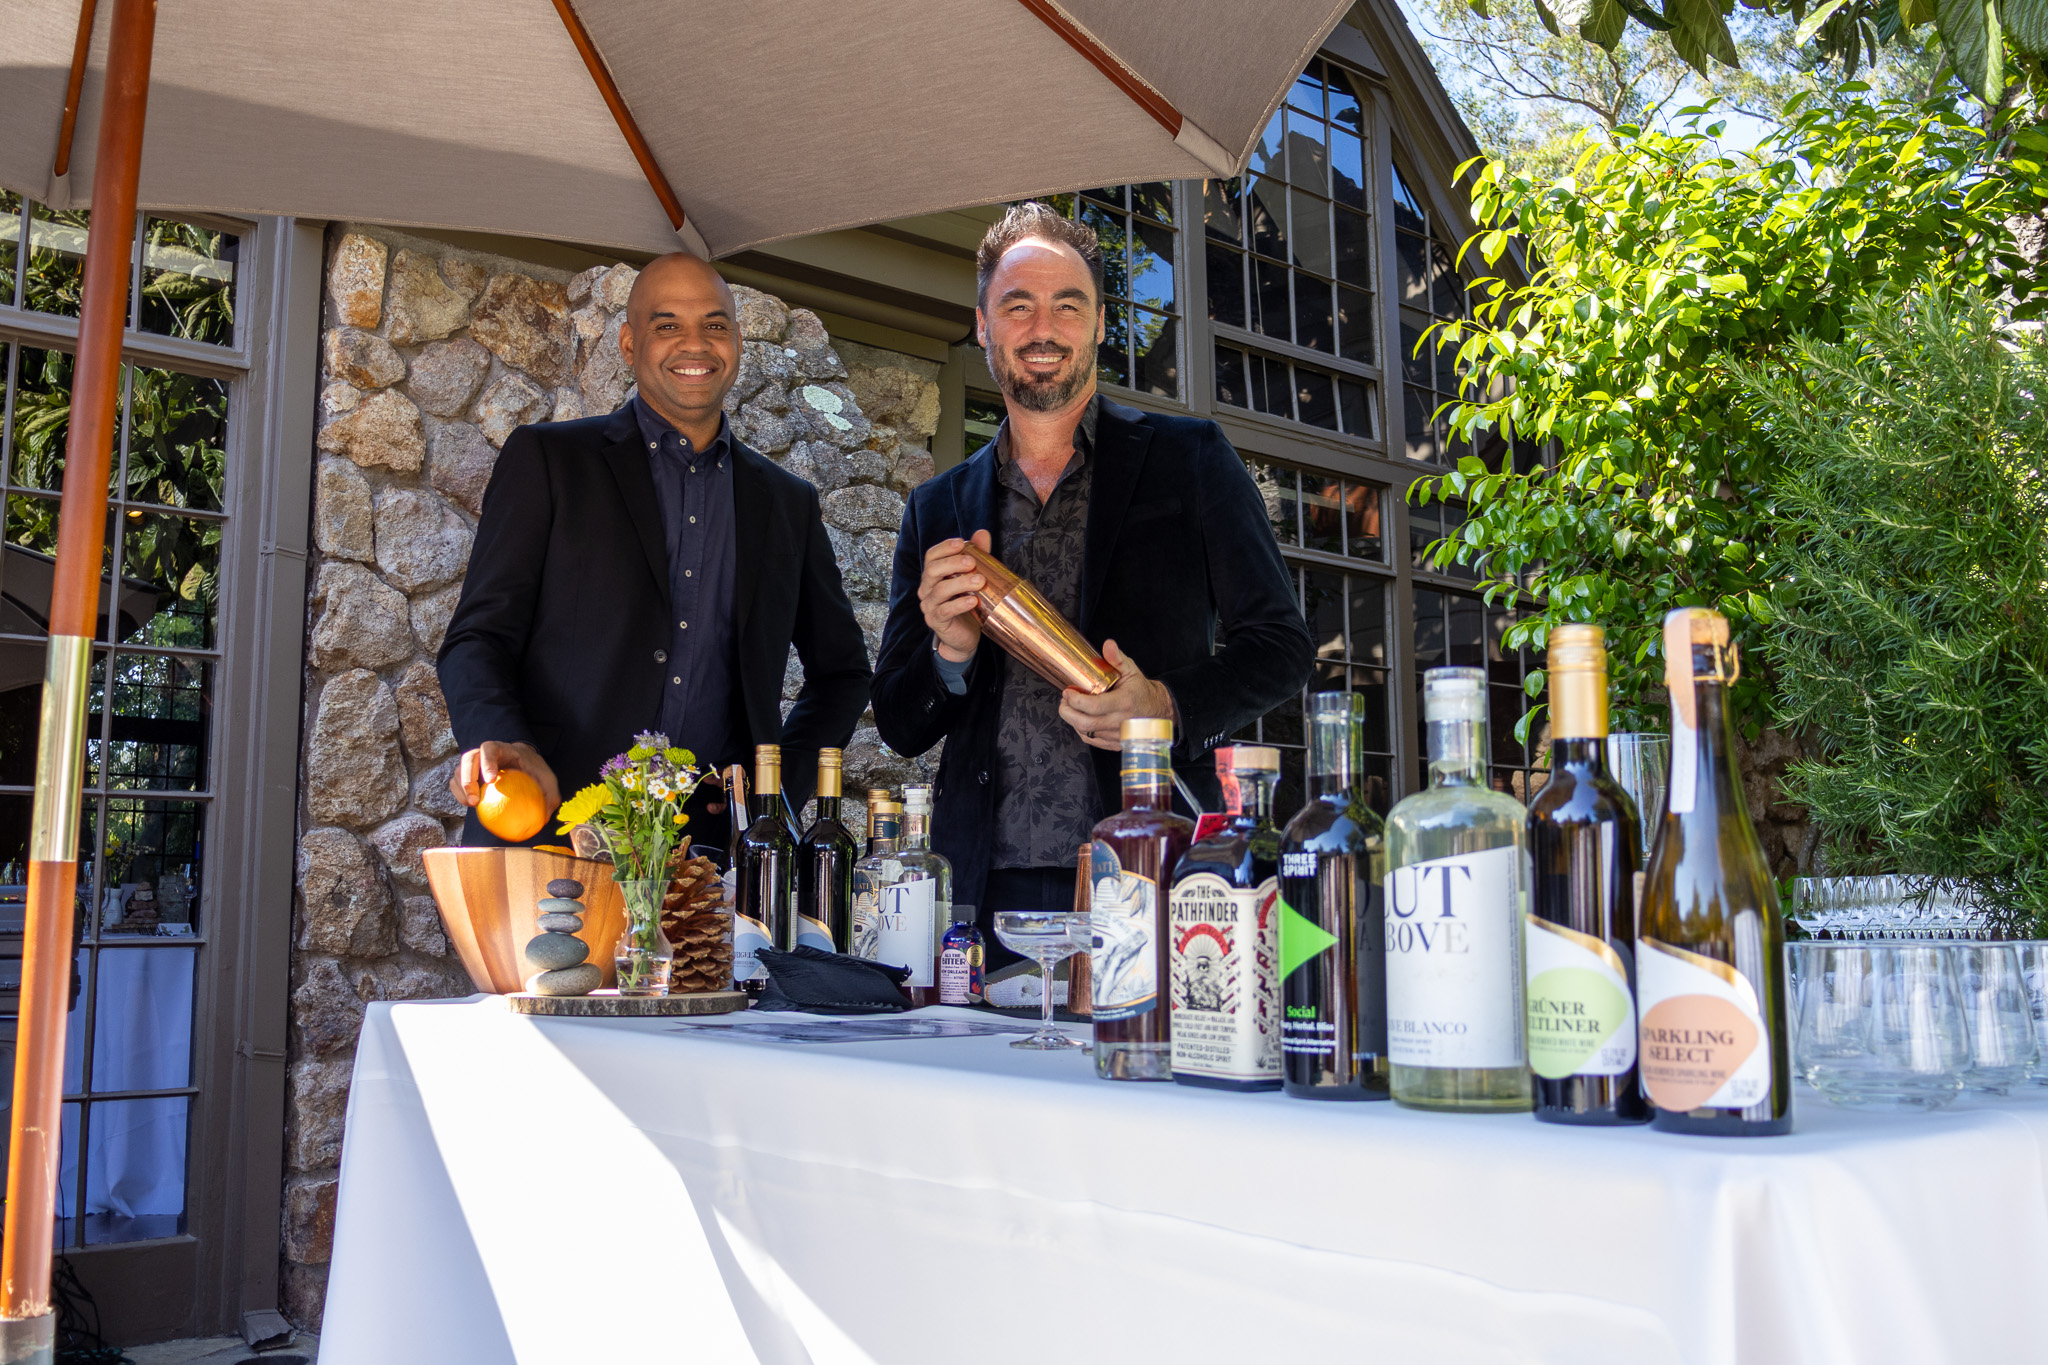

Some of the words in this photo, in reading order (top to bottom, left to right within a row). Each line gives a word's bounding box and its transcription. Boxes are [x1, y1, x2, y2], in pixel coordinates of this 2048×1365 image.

[1282, 853, 1317, 865] THREE
[1282, 864, 1317, 876] SPIRIT
[1197, 885, 1210, 899] THE
[1384, 865, 1471, 919] UT
[1170, 902, 1239, 922] PATHFINDER
[1385, 921, 1470, 954] BOVE
[942, 957, 966, 966] BITTER
[1286, 1005, 1316, 1019] Social
[1403, 1020, 1468, 1035] BLANCO
[1641, 1027, 1735, 1046] PARKLING
[1176, 1051, 1215, 1061] NON-ALCOHOLIC
[1215, 1054, 1232, 1063] SPIRIT
[1649, 1046, 1715, 1064] SELECT
